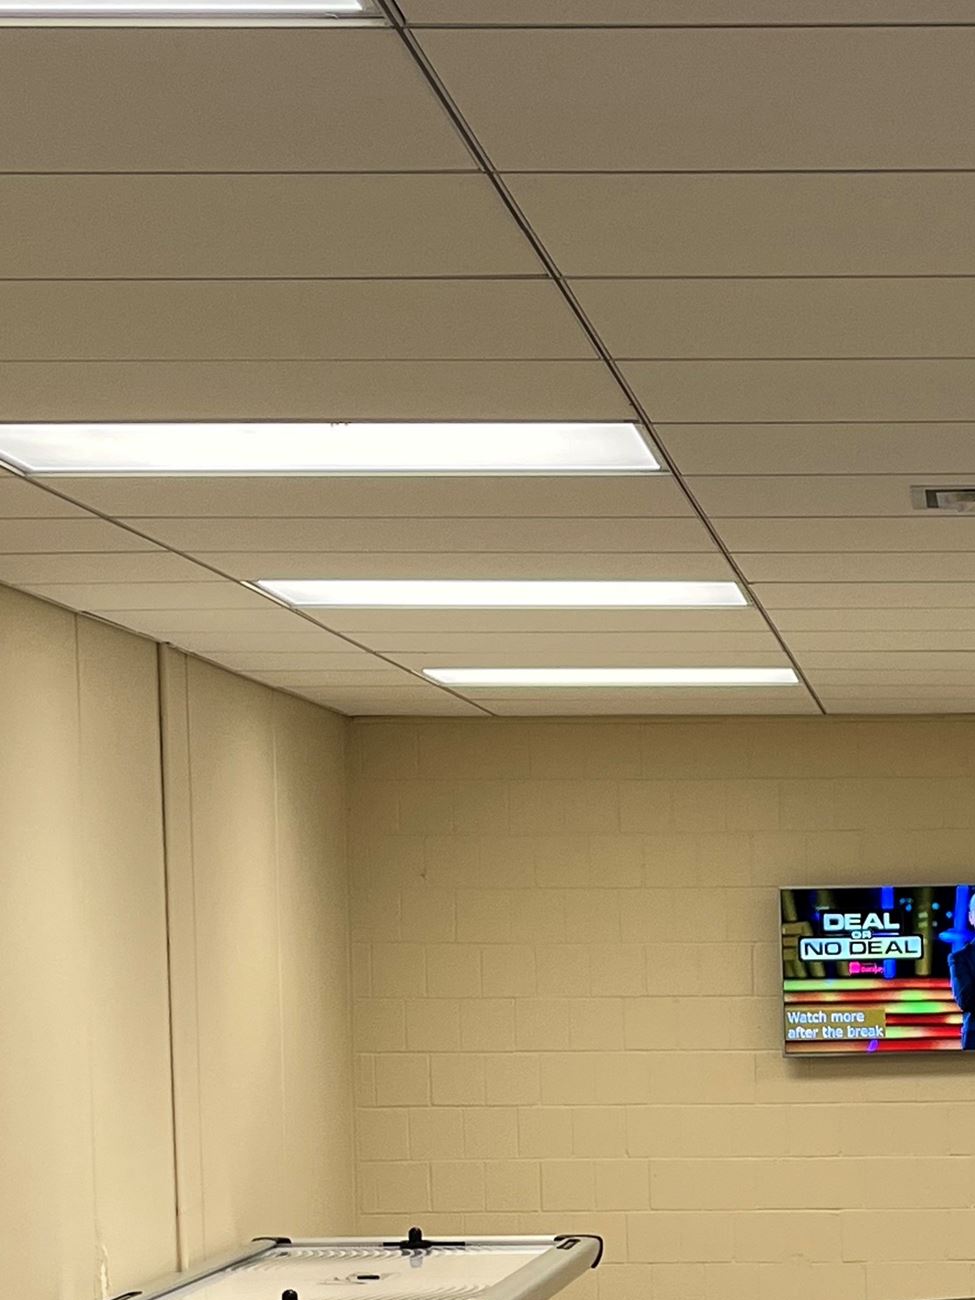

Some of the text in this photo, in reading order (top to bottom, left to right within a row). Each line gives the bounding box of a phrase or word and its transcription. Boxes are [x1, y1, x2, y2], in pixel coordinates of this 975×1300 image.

[823, 912, 900, 931] DEAL
[850, 930, 872, 939] OR
[804, 940, 918, 956] NO DEAL
[787, 1010, 865, 1024] Watch more
[787, 1025, 884, 1039] after the break
